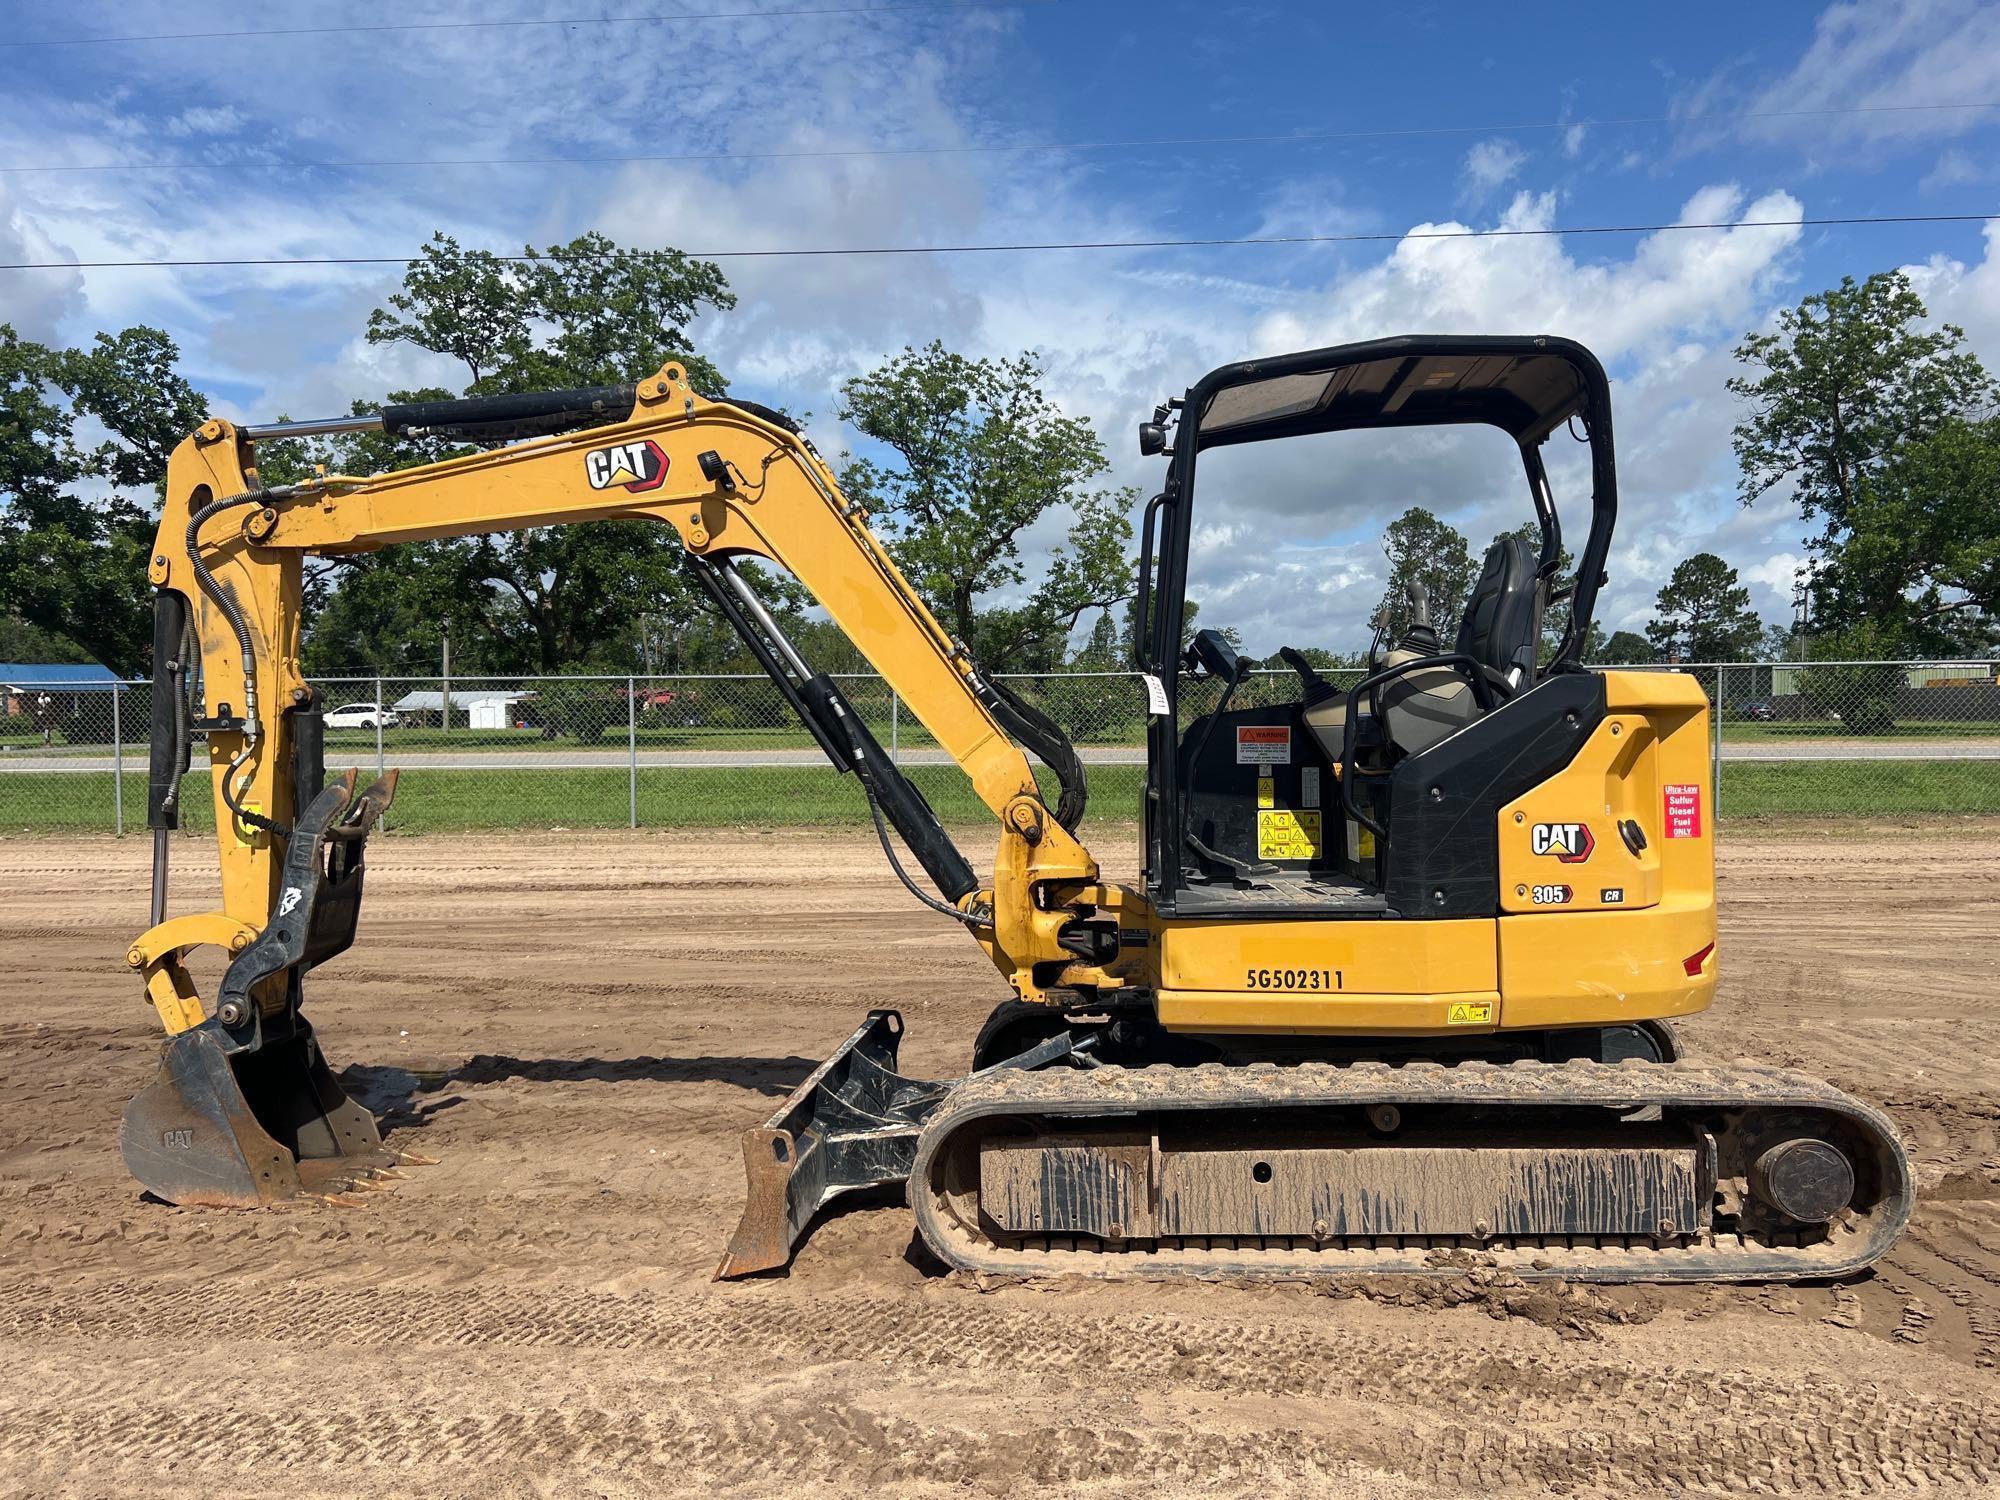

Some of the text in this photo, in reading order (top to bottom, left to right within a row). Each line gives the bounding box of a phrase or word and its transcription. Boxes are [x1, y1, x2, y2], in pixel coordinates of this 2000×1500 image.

[586, 442, 647, 488] CAT
[1665, 785, 1698, 794] Ultra-Low
[1669, 796, 1693, 804] Sulfur
[1669, 807, 1694, 815] Diesel
[1673, 818, 1691, 826] Fuel
[1673, 828, 1692, 836] ONLY
[1532, 824, 1580, 854] CAT
[1533, 886, 1620, 903] 305 CR
[1247, 969, 1343, 989] 5G502311
[163, 1130, 193, 1150] CAT
